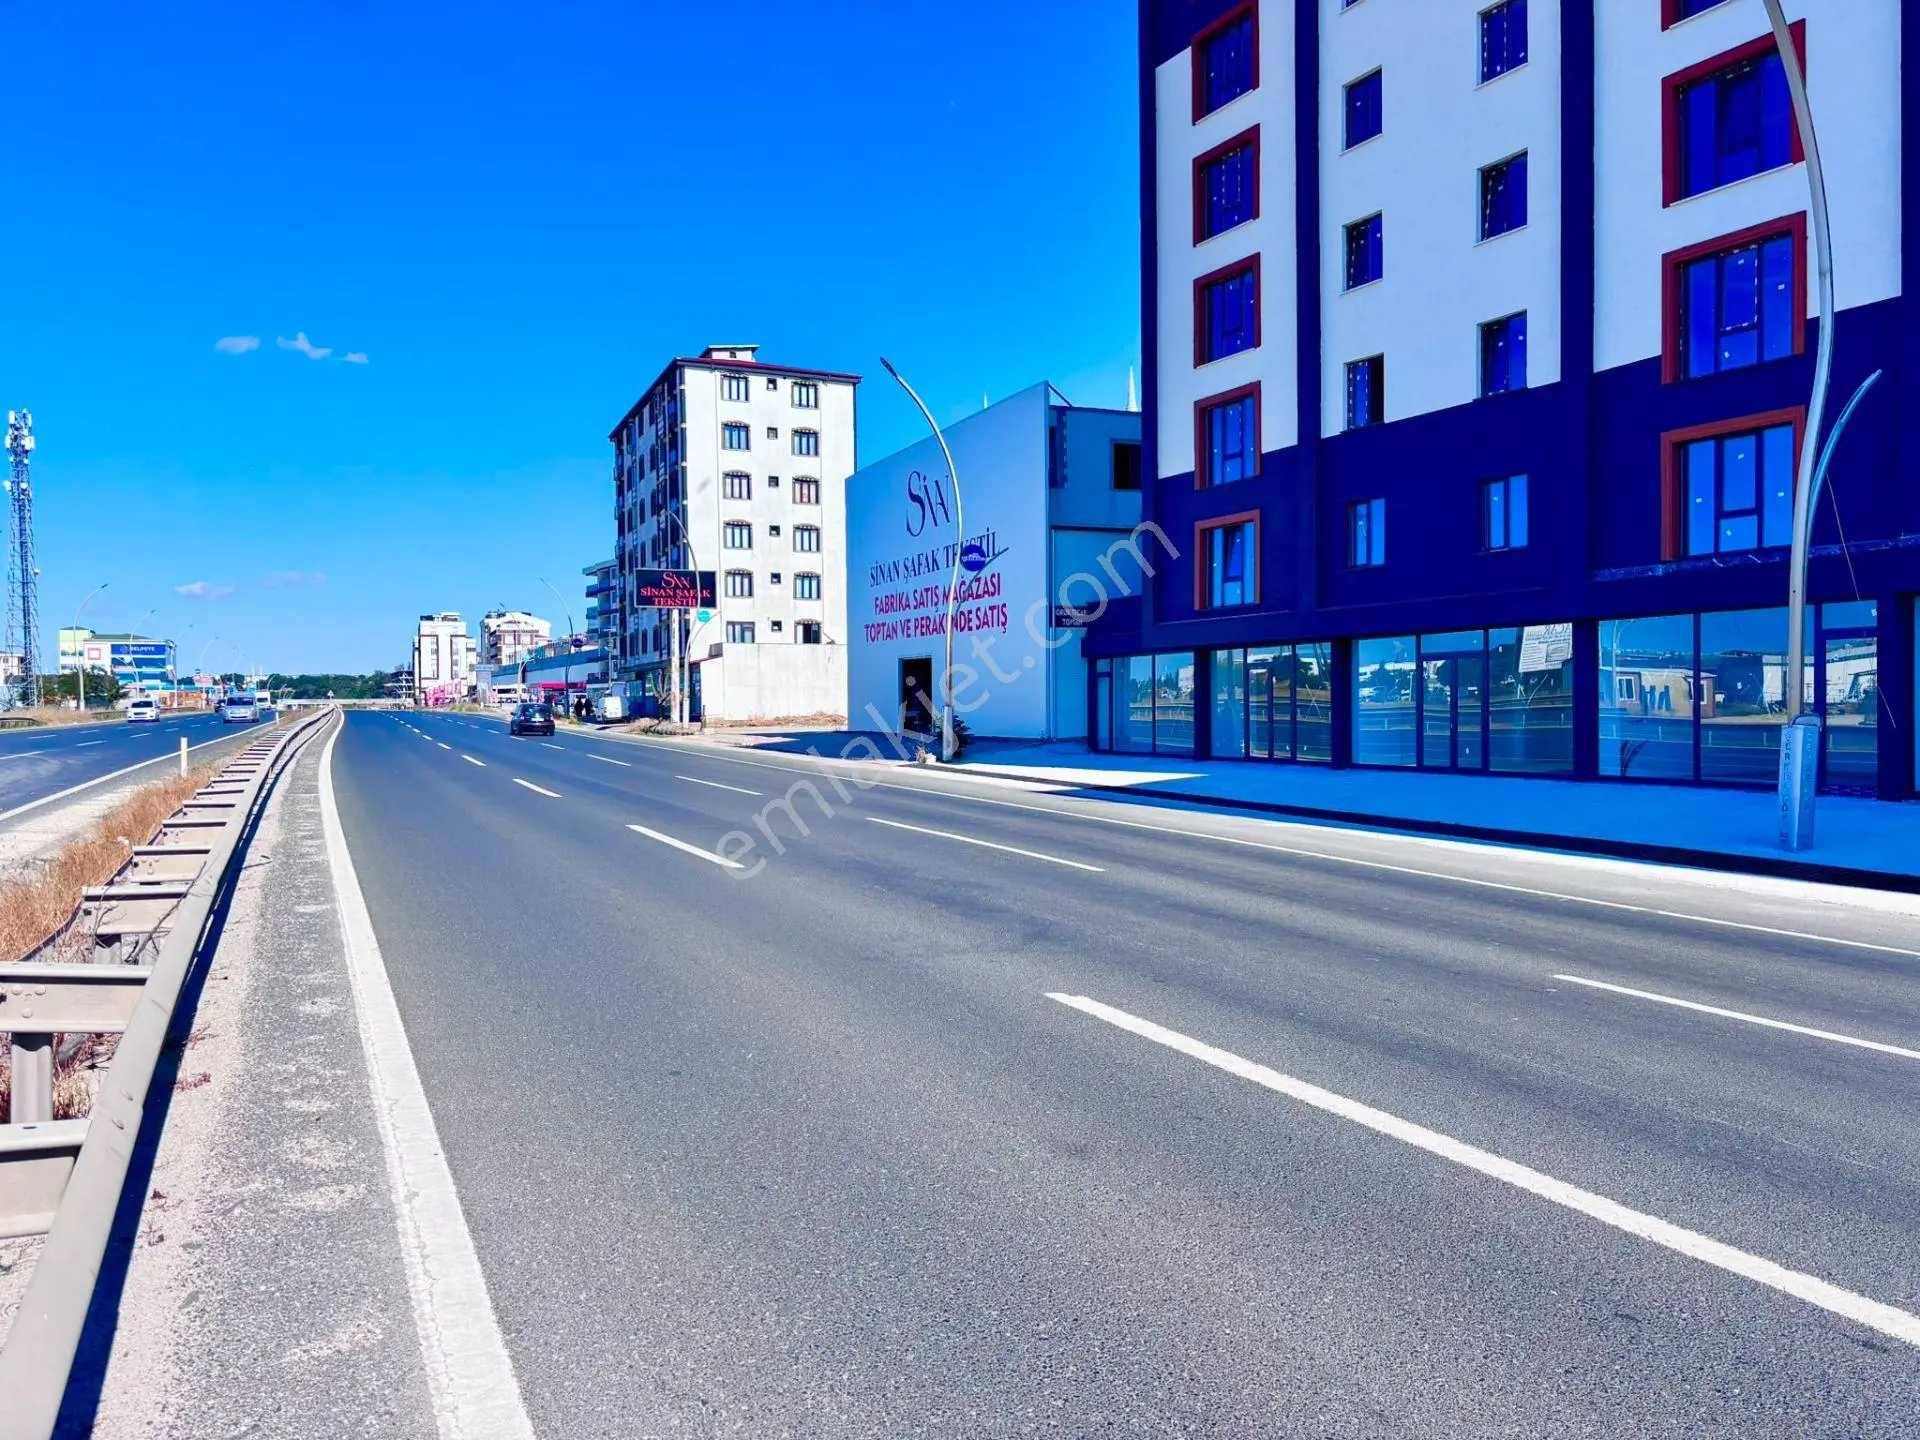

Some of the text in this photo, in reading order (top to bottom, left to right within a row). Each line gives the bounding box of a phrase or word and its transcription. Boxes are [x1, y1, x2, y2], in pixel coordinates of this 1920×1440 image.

[869, 559, 900, 588] SİNAN
[903, 548, 940, 584] ŞAFAK
[640, 586, 674, 597] SİNAN
[874, 572, 1001, 615] FABRİKA SATIŞ MAĞAZASI
[864, 620, 898, 643] TOPTAN
[899, 618, 911, 638] VE
[975, 602, 1008, 634] SATIŞ
